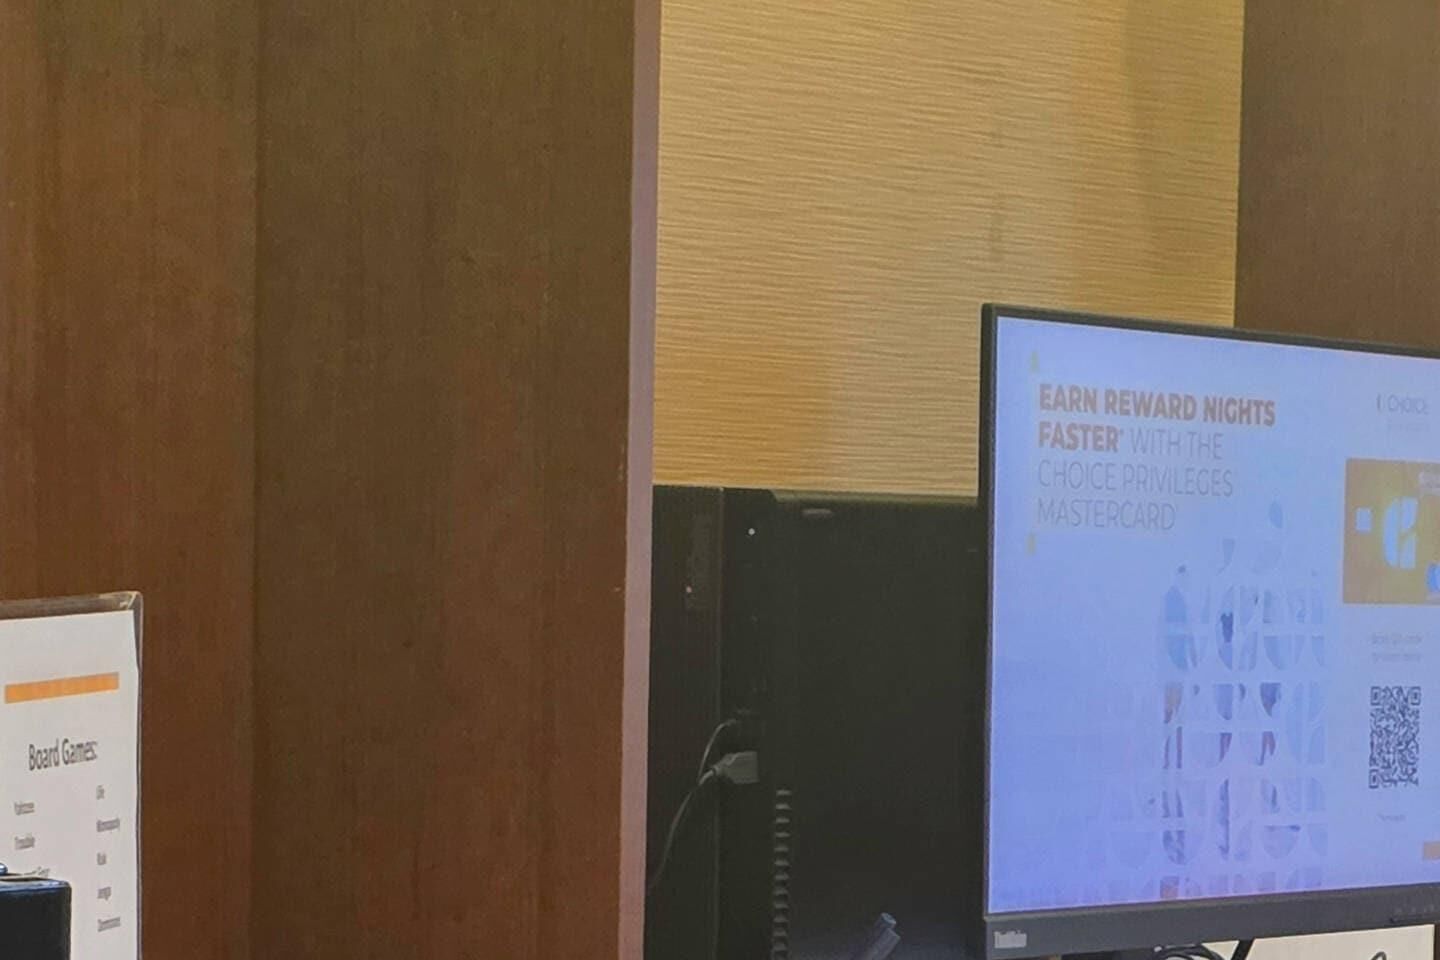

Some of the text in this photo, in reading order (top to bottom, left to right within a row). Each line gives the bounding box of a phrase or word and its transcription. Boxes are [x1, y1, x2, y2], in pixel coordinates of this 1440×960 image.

[1038, 383, 1276, 427] EARN REWARD NIGHTS
[1130, 427, 1182, 457] WITH
[1187, 430, 1225, 460] THE
[1037, 458, 1234, 497] CHOICE PRIVILEGES
[1036, 497, 1177, 530] MASTERCARD
[28, 738, 60, 771] Board
